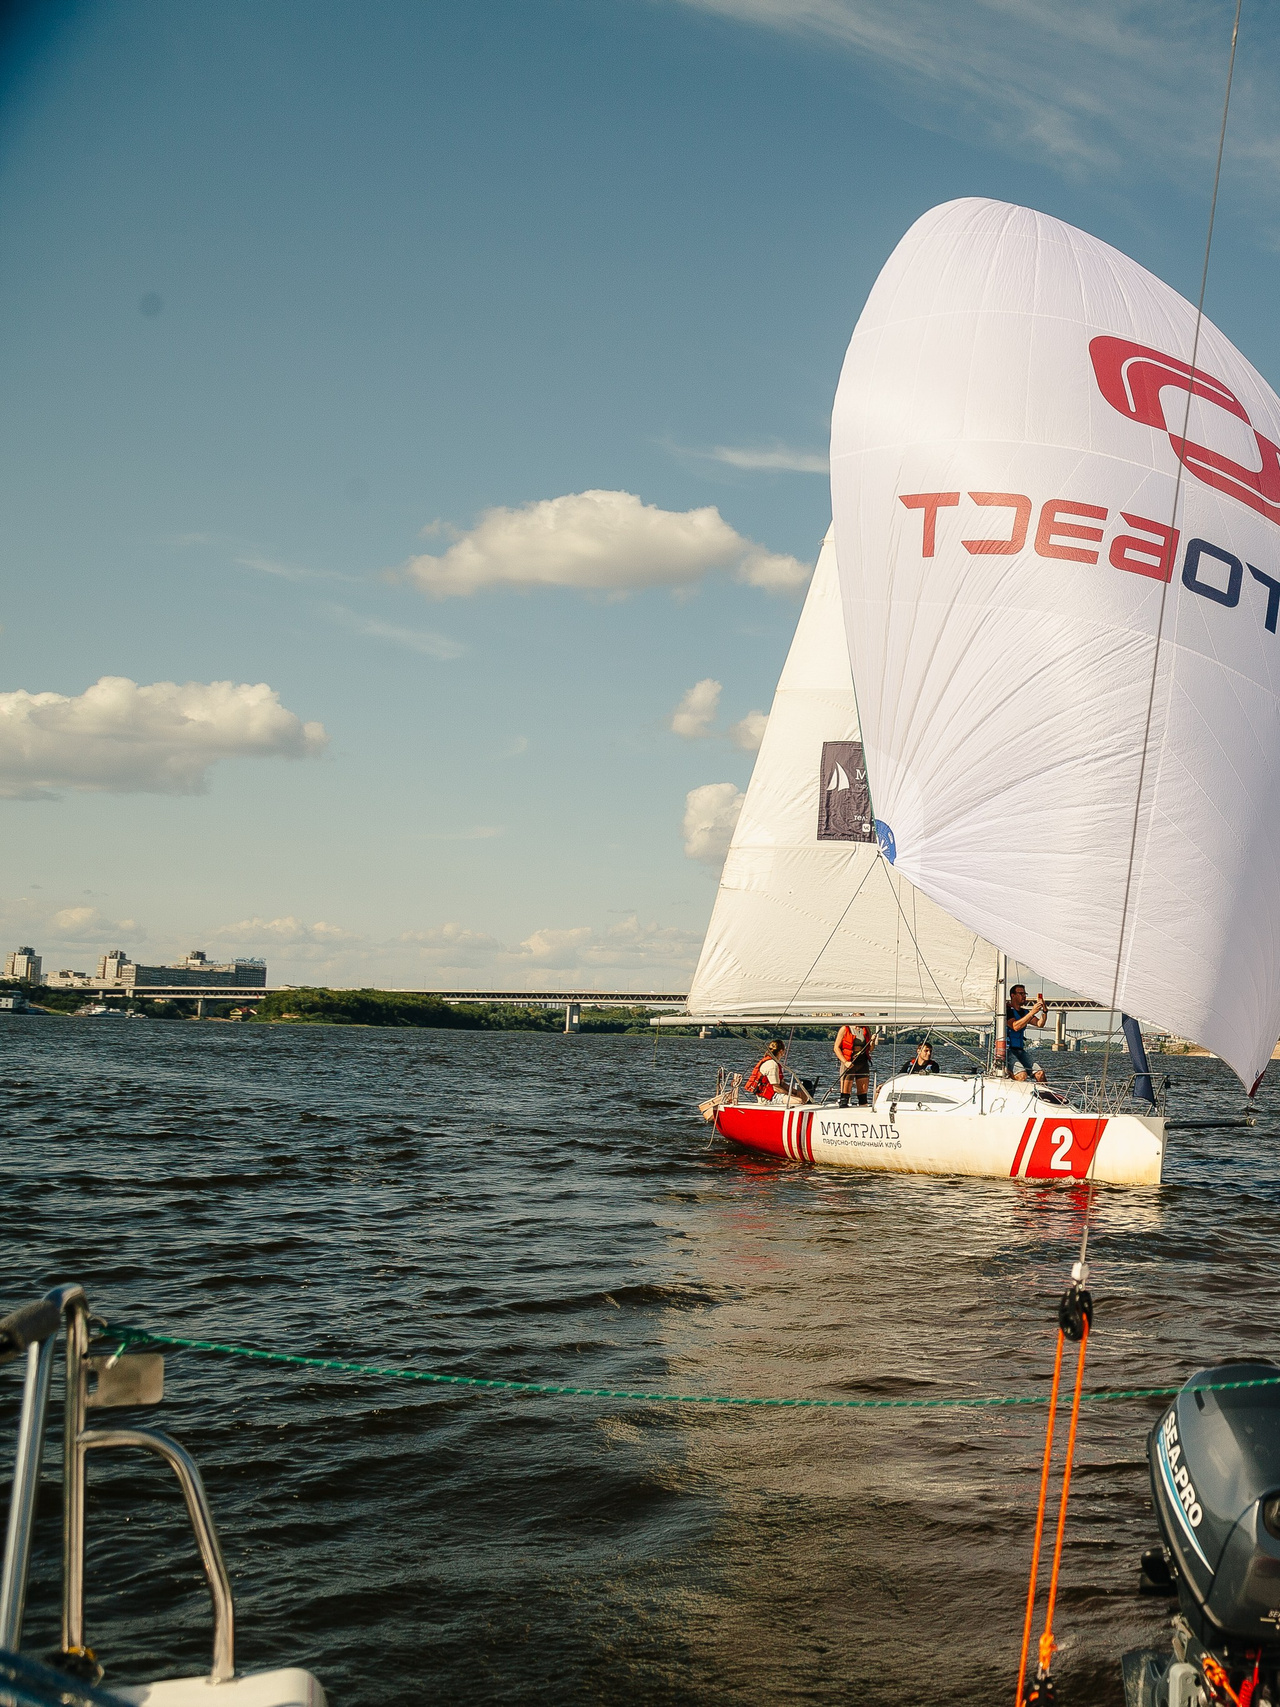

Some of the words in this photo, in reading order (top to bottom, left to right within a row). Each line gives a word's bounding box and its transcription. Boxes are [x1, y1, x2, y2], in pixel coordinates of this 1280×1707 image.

[820, 1121, 900, 1139] МИСТРАЛЬ
[822, 1138, 884, 1148] парусно-гоночный
[885, 1140, 902, 1149] клуб
[1050, 1126, 1073, 1170] 2
